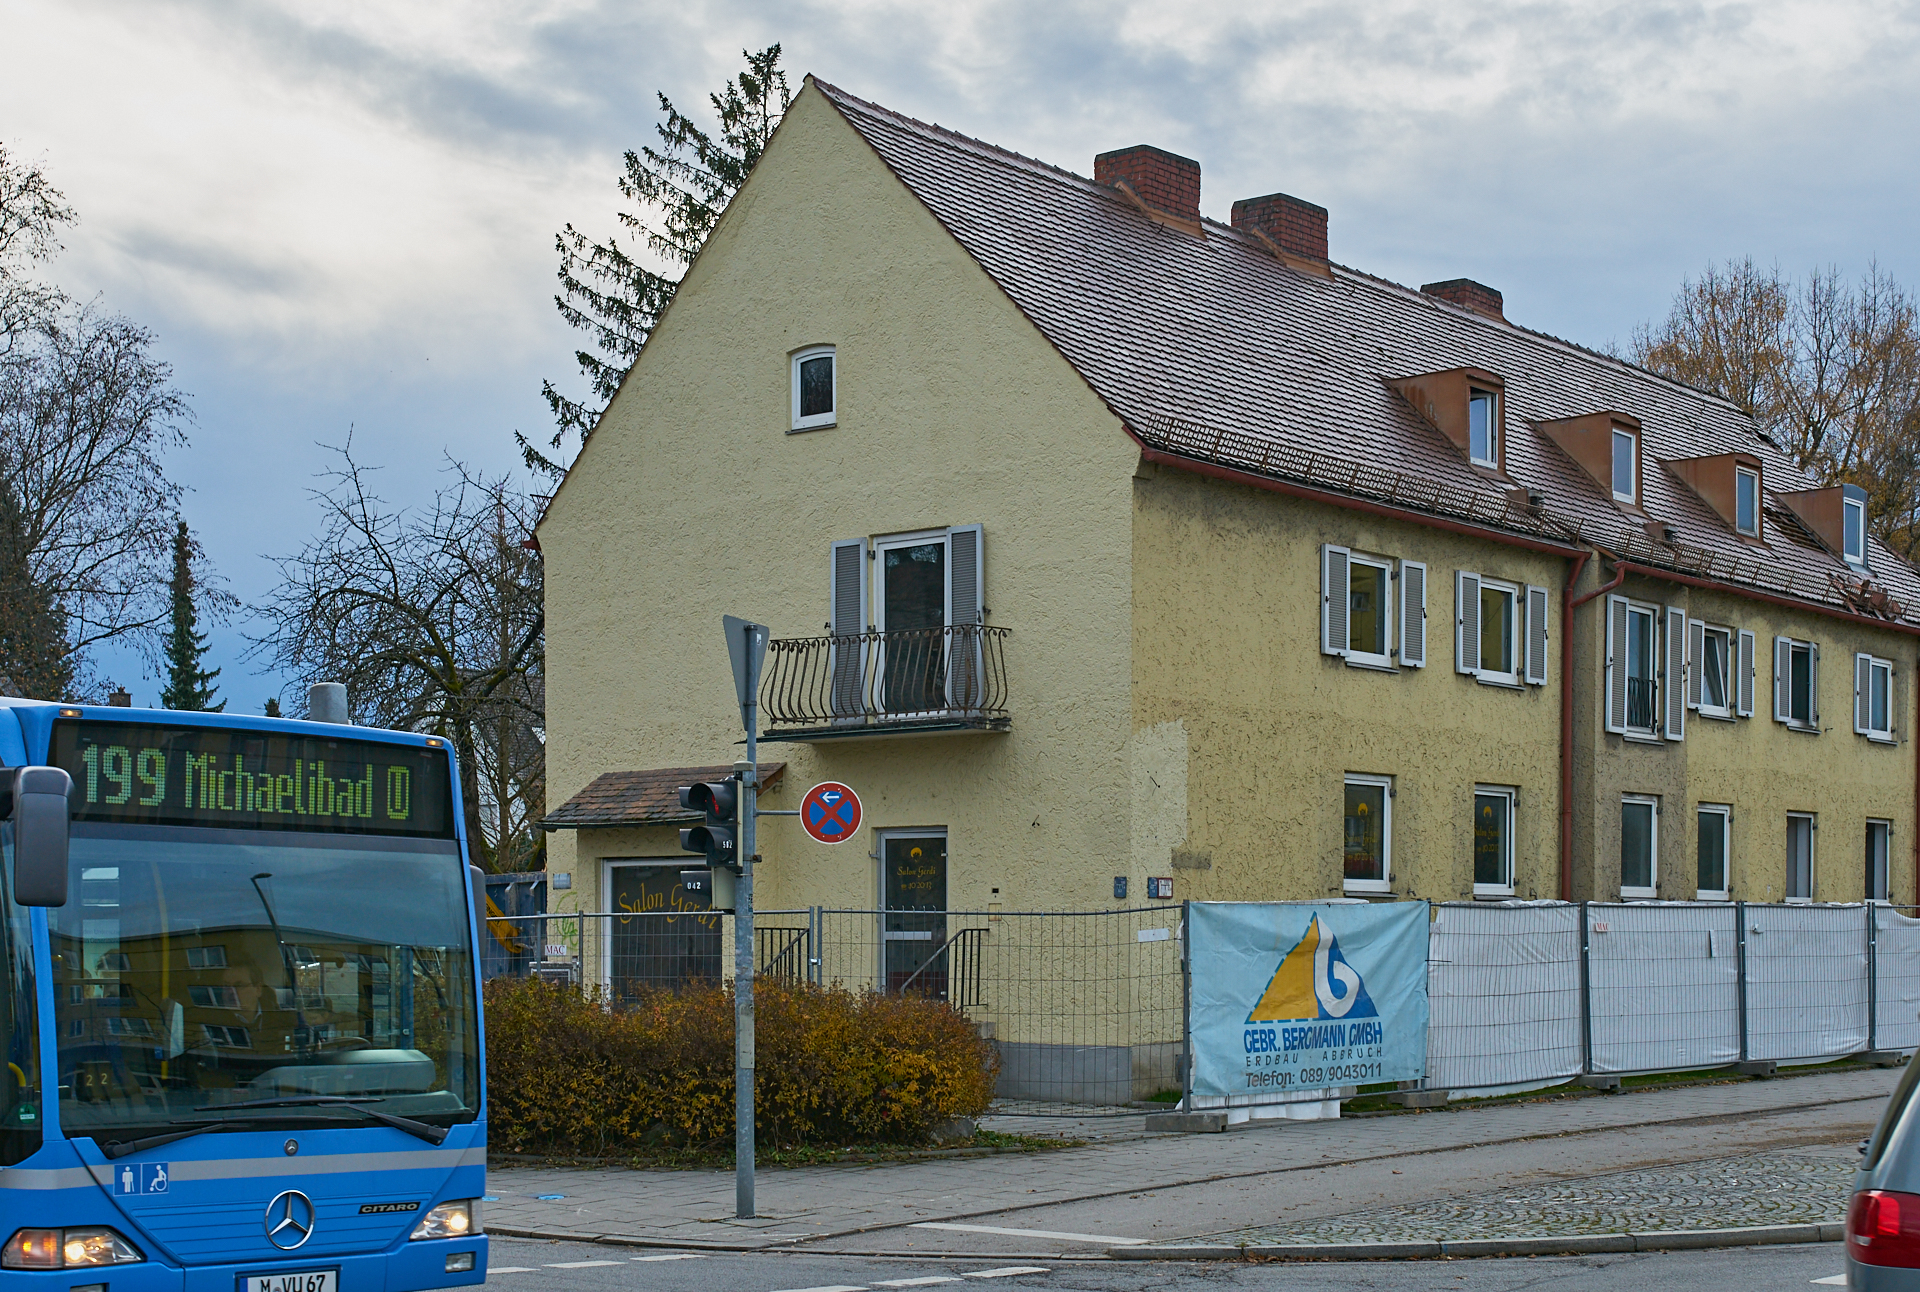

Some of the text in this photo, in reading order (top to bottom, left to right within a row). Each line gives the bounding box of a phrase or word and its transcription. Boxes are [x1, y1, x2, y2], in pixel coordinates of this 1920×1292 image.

[82, 744, 165, 806] 199
[185, 750, 373, 818] Michaelibad
[687, 882, 701, 890] 042
[619, 882, 665, 924] Salon
[666, 884, 718, 929] Gerdi
[546, 945, 565, 955] MAC
[1243, 1021, 1382, 1053] GEBR. BERGMANN GMBH
[1246, 1047, 1382, 1067] ERDBAU ABBRUCH
[1246, 1062, 1382, 1088] Telefon: 089/9043011
[361, 1203, 418, 1213] CITARO
[261, 1274, 326, 1292] M VU 67
